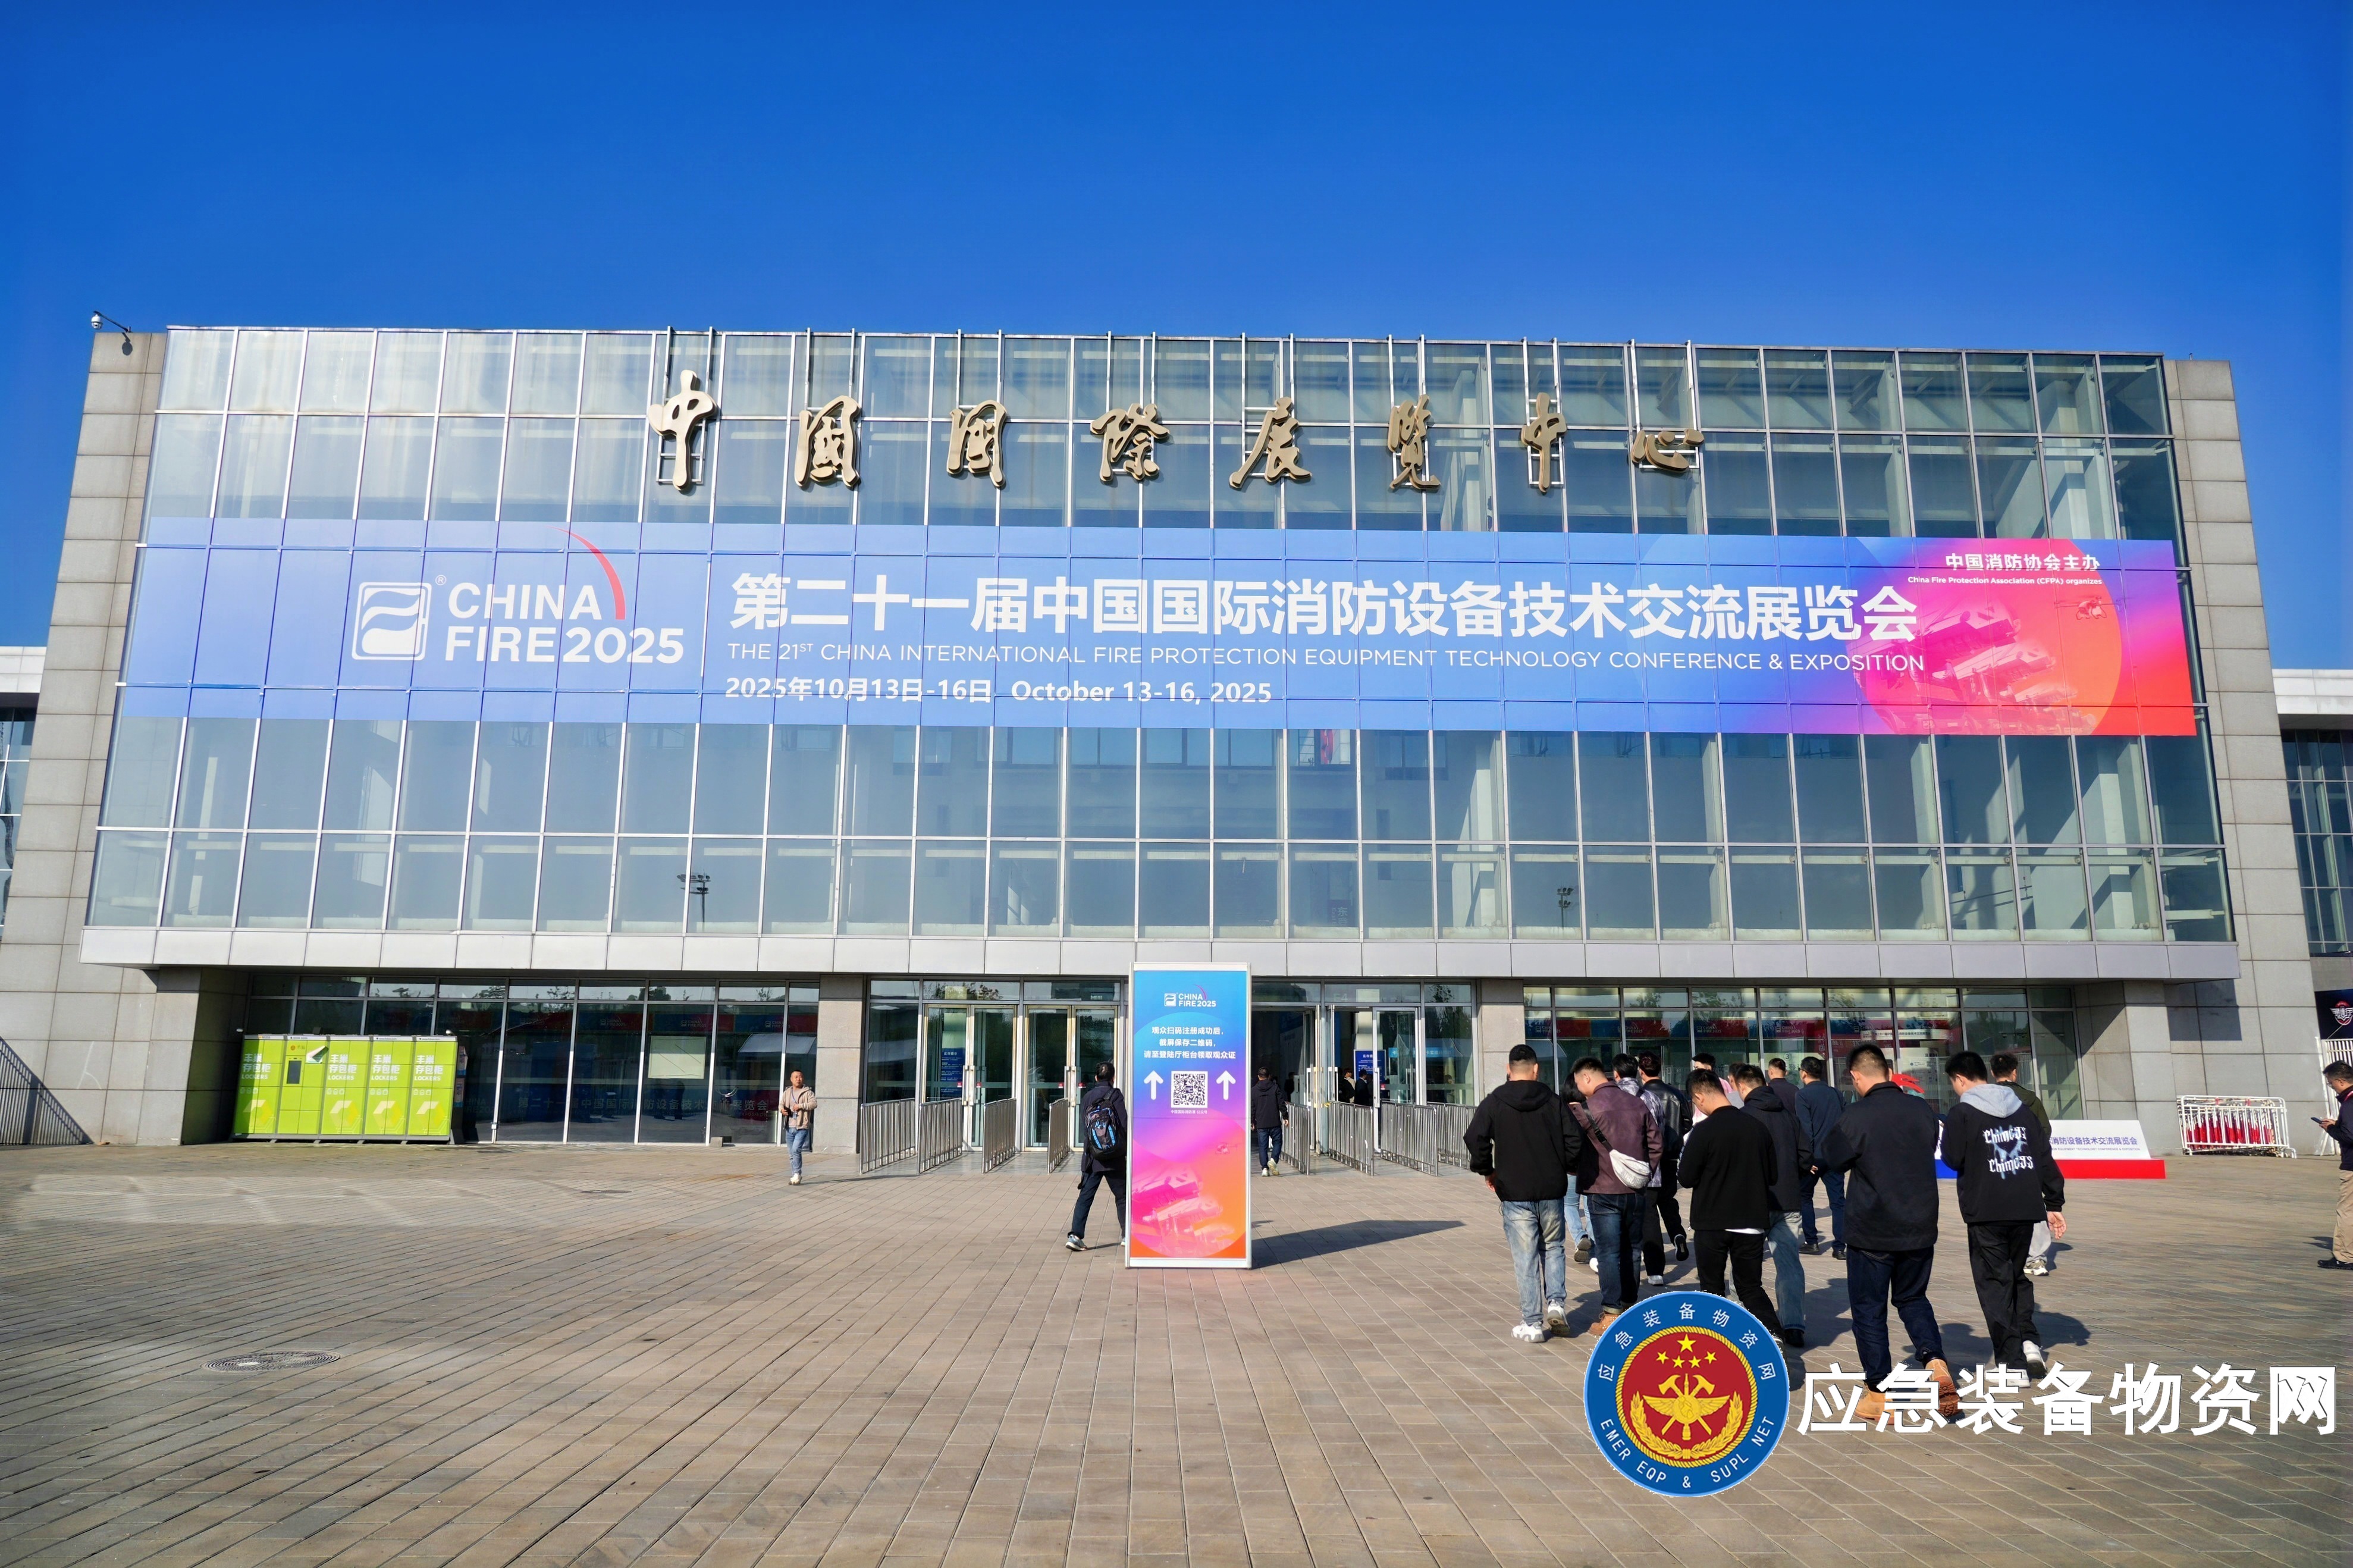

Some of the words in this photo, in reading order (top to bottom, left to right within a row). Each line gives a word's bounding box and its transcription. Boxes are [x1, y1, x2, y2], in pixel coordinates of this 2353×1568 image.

[1946, 553, 2100, 571] 中国消防协会主办
[448, 582, 602, 620] CHINA
[729, 573, 1919, 642] 第二十一届中国国际消防设备技术交流展览会
[727, 644, 770, 660] THE
[821, 644, 892, 661] CHINA
[901, 645, 1085, 663] INTERNATIONAL
[1094, 647, 1142, 663] FIRE
[1151, 648, 1296, 665] PROTECTION
[1306, 649, 1438, 666] EQUIPMENT
[1447, 650, 1601, 667] TECHNOLOGY
[1610, 651, 1762, 670] CONFERENCE
[1769, 654, 1783, 670] &
[1791, 654, 1925, 671] EXPOSITION
[724, 676, 992, 702] 2025年10月13日-16日
[1011, 680, 1114, 703] October
[1123, 682, 1201, 705] 13-16,
[1210, 682, 1272, 703] 2025
[1144, 1050, 1236, 1059] 请至登陆厅柜台领取观众证
